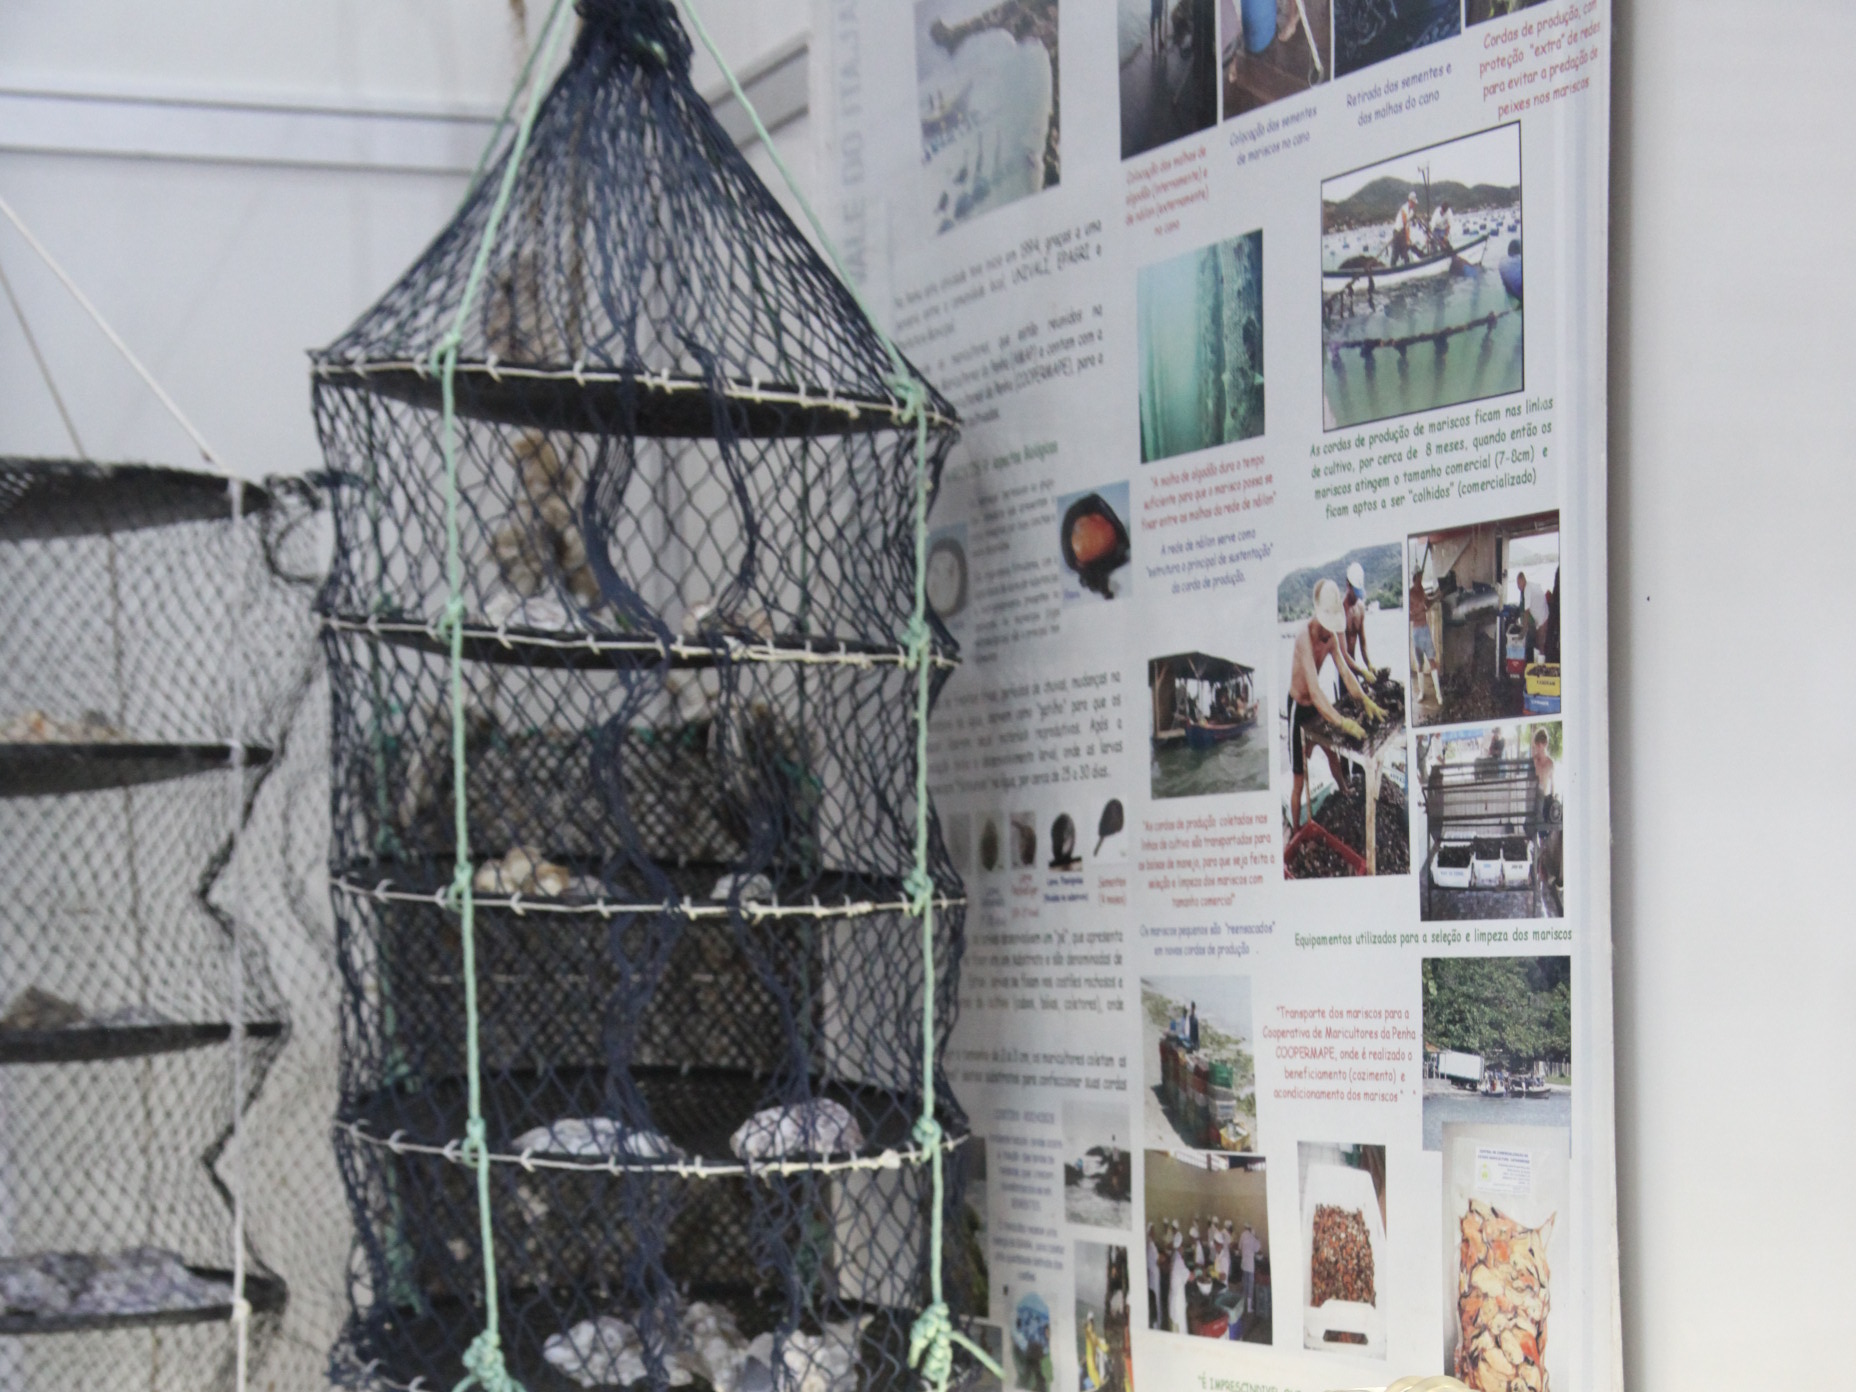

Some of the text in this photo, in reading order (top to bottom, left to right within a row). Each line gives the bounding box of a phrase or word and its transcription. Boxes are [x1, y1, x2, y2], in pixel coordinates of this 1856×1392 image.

[1484, 28, 1518, 49] Cordas
[1522, 22, 1533, 37] de
[1480, 48, 1524, 79] proteção
[1568, 29, 1578, 45] de
[1347, 63, 1452, 108] Retirada das sementes e
[1484, 81, 1505, 101] para
[1508, 71, 1538, 89] evitar
[1541, 68, 1546, 79] a
[1498, 77, 1589, 121] peixes nos mariscos
[1358, 90, 1439, 126] das malhas do cano
[1310, 444, 1320, 457] As
[1323, 438, 1351, 456] cordas
[1355, 434, 1365, 446] de
[1369, 423, 1409, 446] produção
[1413, 421, 1424, 436] de
[1429, 415, 1470, 432] mariscos
[1475, 408, 1500, 425] ficam
[1506, 405, 1521, 417] nas
[1311, 422, 1552, 478] de cultivo, por cerca de 8 meses, quando então os
[1315, 445, 1548, 501] mariscos atingem o tamanho comercial (7-8cm) e
[1326, 503, 1349, 520] ficam
[1353, 498, 1377, 516] aptos
[1381, 497, 1386, 509] a
[1391, 494, 1405, 507] ser
[1458, 467, 1536, 498] (comercializado)
[1295, 928, 1572, 949] Equipamentos utilizados para a seleção e limpeza dos mariscos
[1329, 1006, 1344, 1019] dos
[1346, 1008, 1382, 1019] mariscos
[1384, 1008, 1402, 1022] para
[1404, 1009, 1409, 1019] a
[1263, 1026, 1416, 1041] Cooperativa de Maricultores da Penha
[1276, 1046, 1412, 1061] COOPERMAPE, onde é realizado o
[1284, 1066, 1405, 1084] beneficiamento (cozimento) e
[1274, 1086, 1344, 1100] acondicionamento
[1347, 1088, 1361, 1101] dos
